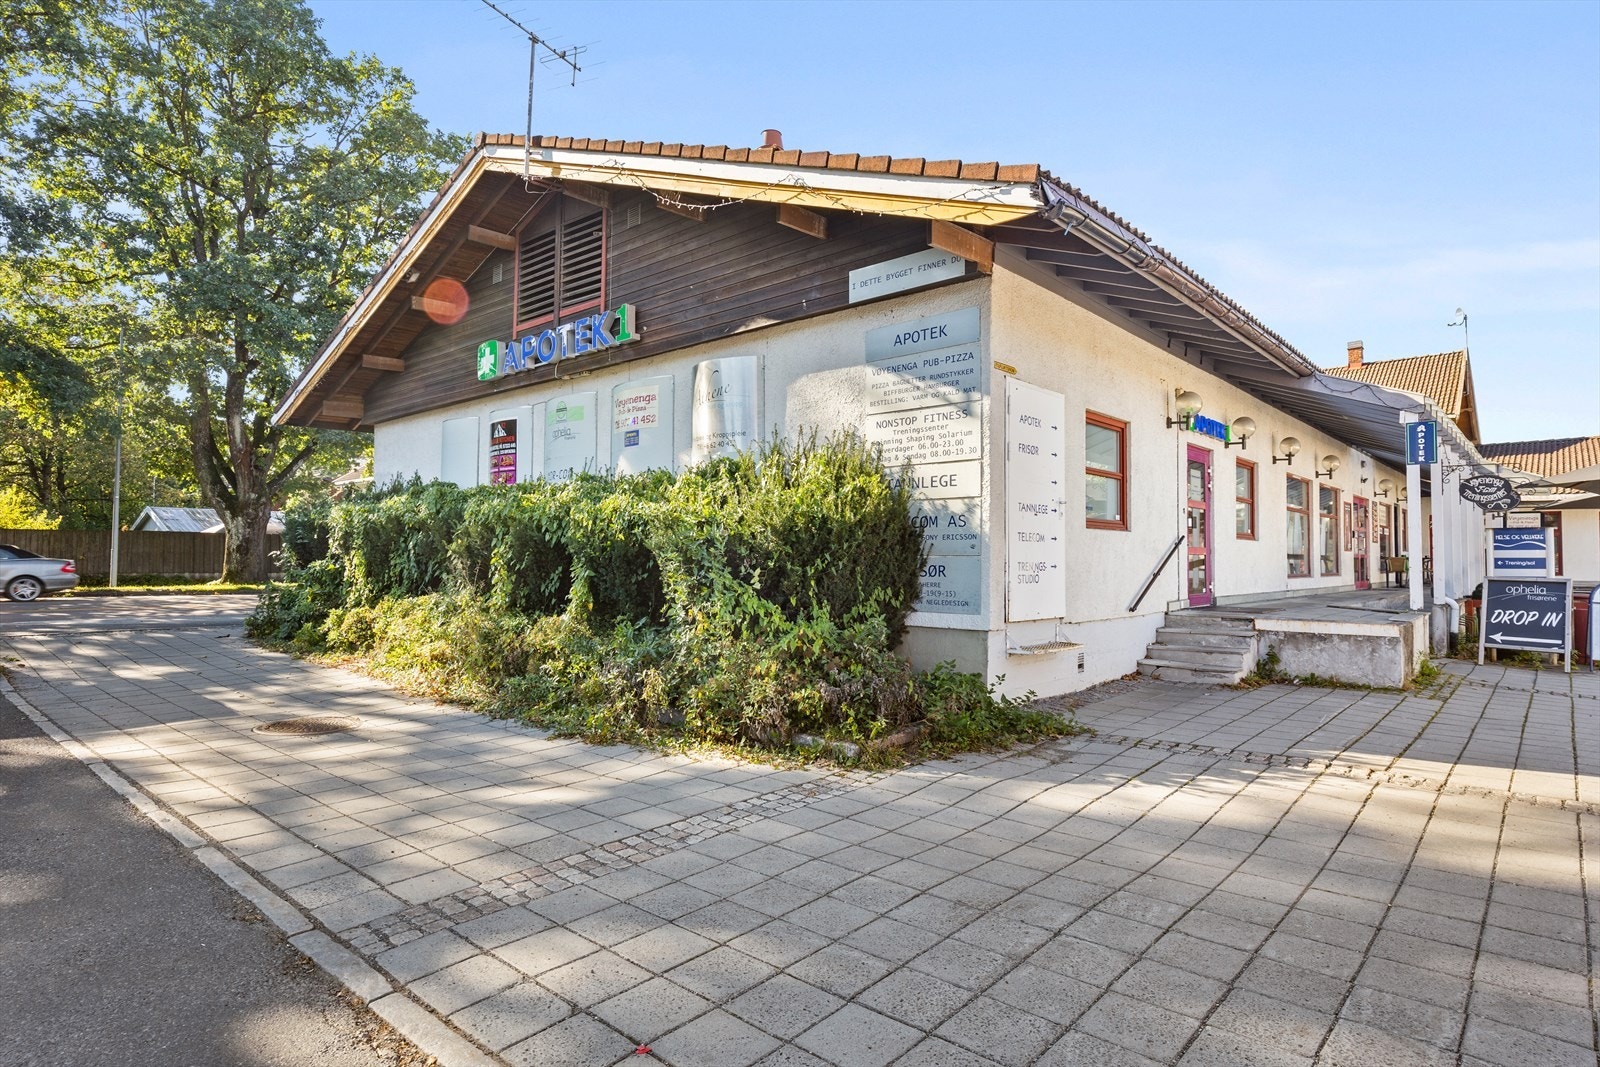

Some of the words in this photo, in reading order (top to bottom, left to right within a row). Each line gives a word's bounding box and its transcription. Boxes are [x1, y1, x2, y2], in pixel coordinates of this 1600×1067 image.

[860, 276, 882, 288] DETTE
[885, 268, 914, 281] BYGGET
[917, 259, 947, 272] FINNER
[951, 256, 962, 264] DU
[615, 303, 641, 342] 1
[503, 310, 619, 374] APOTEK
[893, 324, 948, 347] APOTEK
[871, 361, 918, 377] VØYENENGA
[923, 352, 975, 368] PUB-PIZZA
[871, 382, 890, 390] PIZZA
[892, 376, 926, 386] BAGUETTER
[929, 368, 975, 380] RUNDSTYKKER
[883, 386, 921, 397] BIFFBURGER
[923, 379, 960, 390] HAMBURGER
[869, 397, 909, 407] BESTILLING:
[912, 393, 929, 401] VARM
[943, 389, 960, 397] KALD
[963, 386, 977, 394] MAT
[640, 414, 657, 424] 452
[876, 416, 918, 429] NONSTOP
[924, 409, 968, 423] FITNESS
[1018, 414, 1042, 428] APOTEK
[893, 424, 949, 436] Treningssenter
[874, 438, 903, 447] pinning
[906, 435, 935, 443] Shaping
[938, 430, 973, 440] Solarium
[879, 445, 914, 453] verdager
[917, 439, 964, 450] 06.00-23.00
[1417, 424, 1426, 462] APOTEK
[930, 447, 978, 458] 08.00-19.30
[1018, 502, 1048, 514] TANNLEGE
[947, 514, 967, 528] AS
[942, 533, 978, 541] ERICSSON
[1017, 531, 1045, 542] TELECOM
[1017, 573, 1040, 584] STUDIO
[1505, 584, 1547, 595] ophelia
[926, 599, 969, 607] NEGLEDESIGN
[1490, 609, 1539, 625] DROP
[1541, 612, 1563, 627] IN
